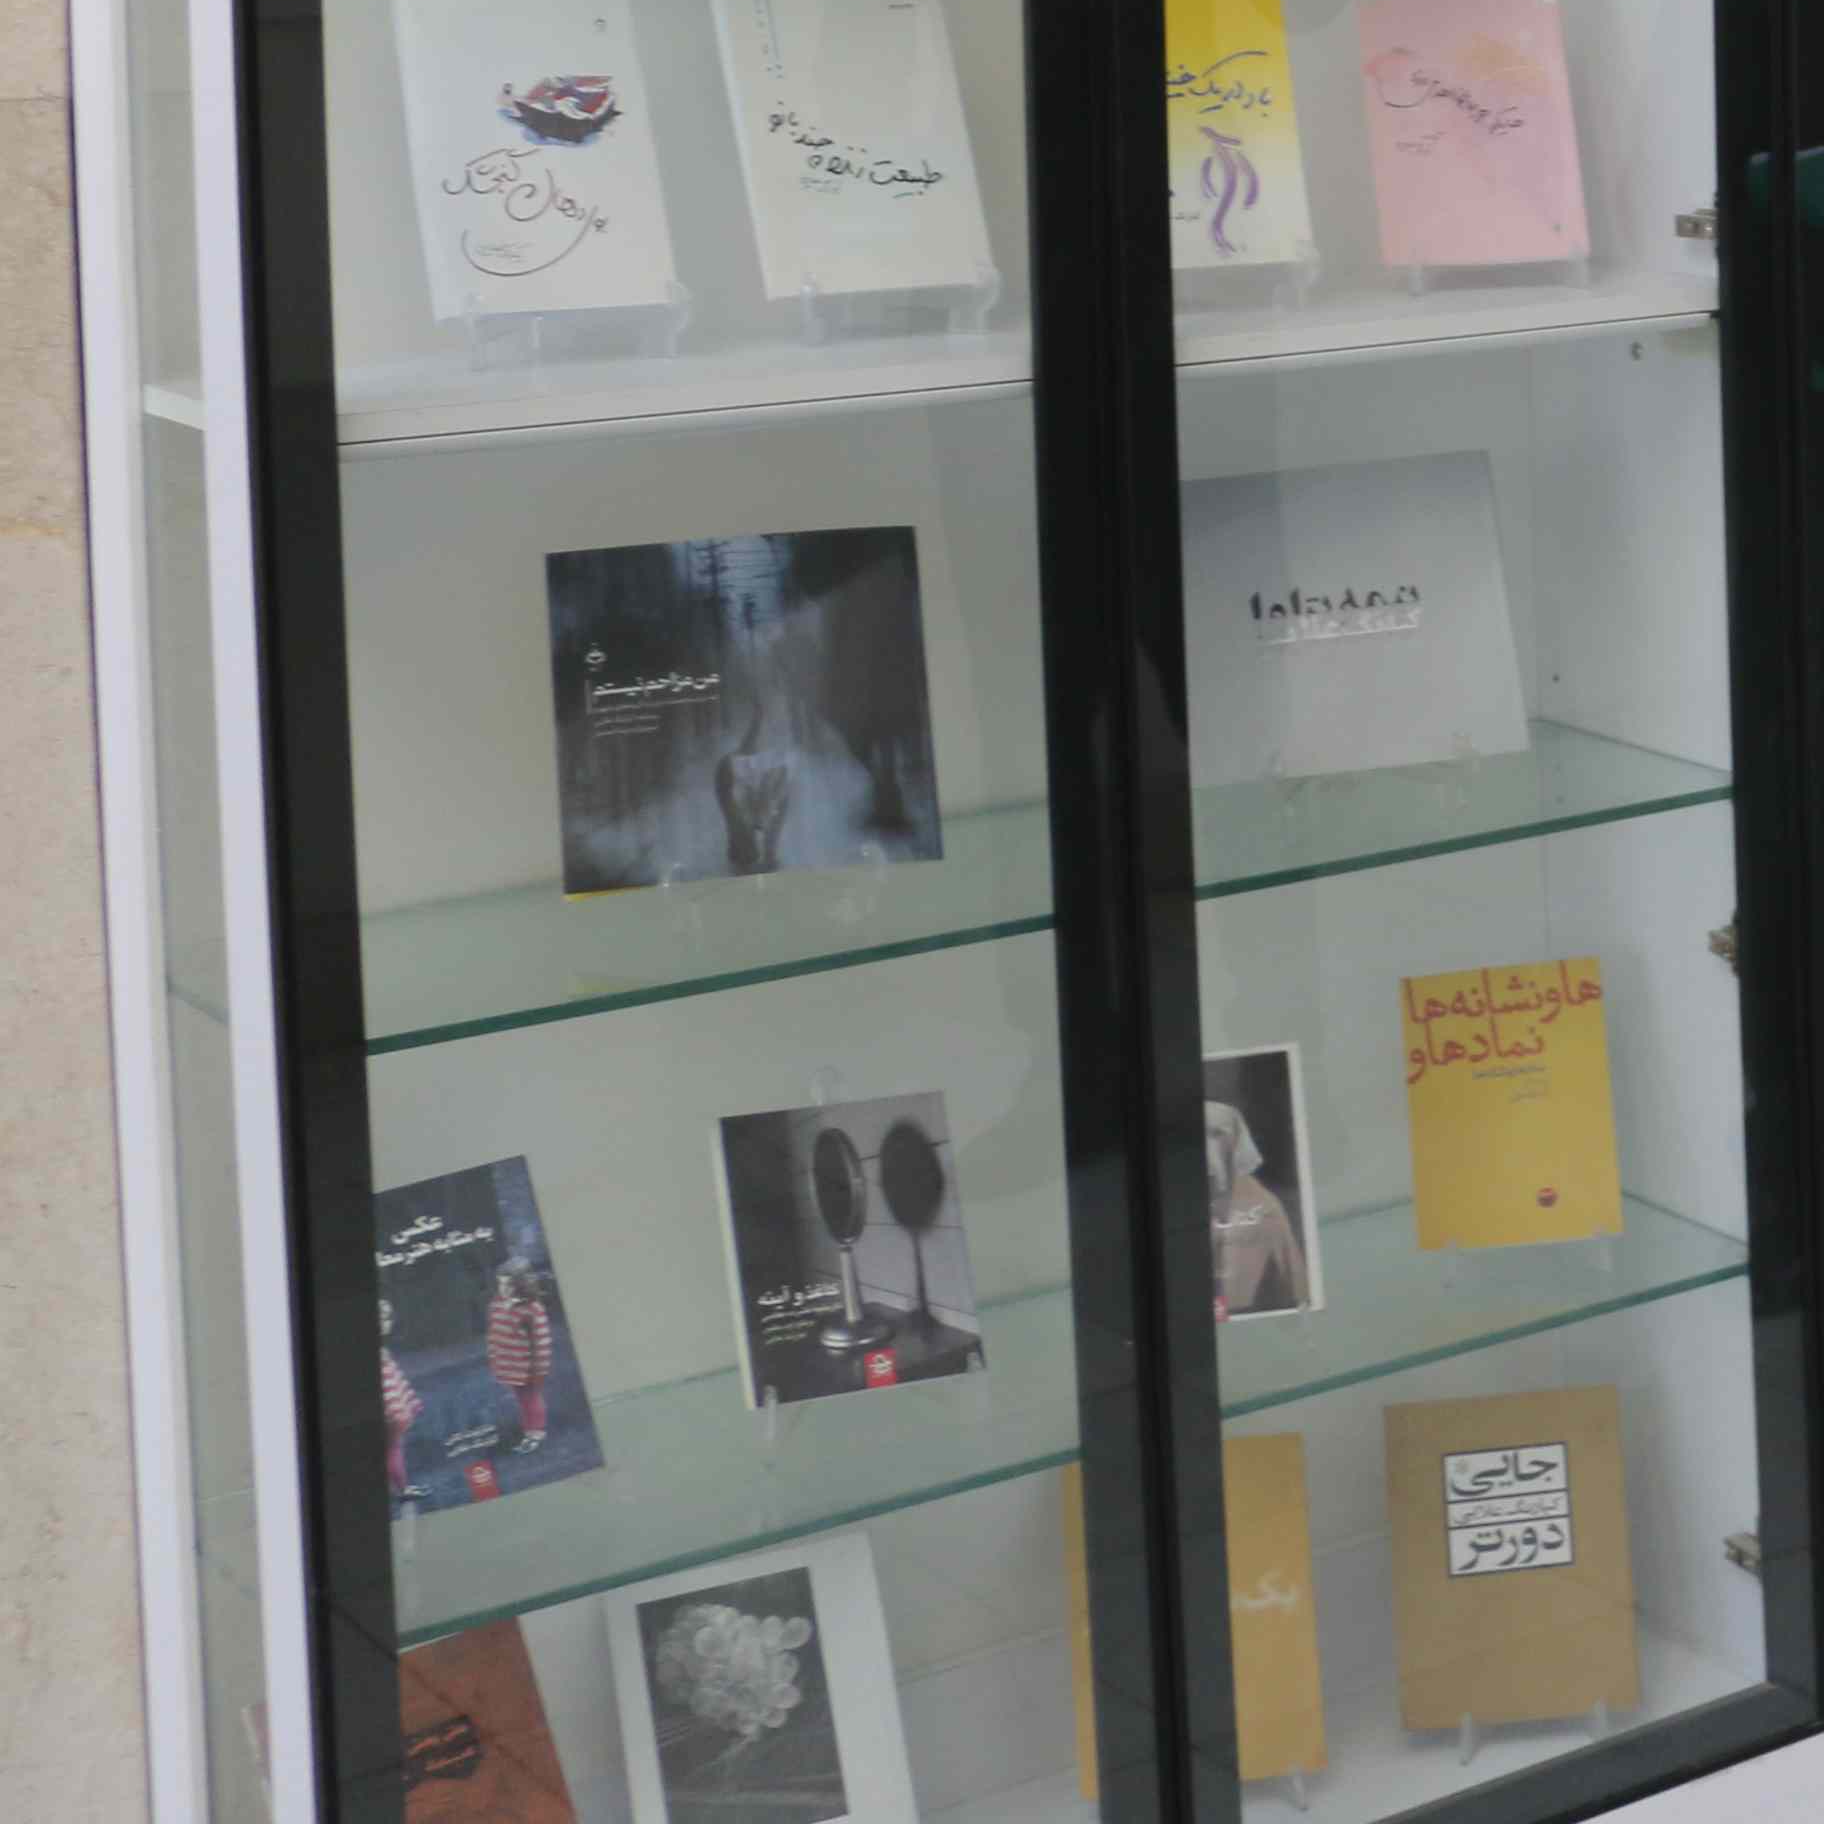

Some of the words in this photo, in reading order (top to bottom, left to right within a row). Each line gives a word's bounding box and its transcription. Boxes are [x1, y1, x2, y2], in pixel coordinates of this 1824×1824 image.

[390, 1215, 443, 1245] عکس
[1450, 1451, 1559, 1496] جایی
[1457, 1523, 1565, 1571] دورتر
